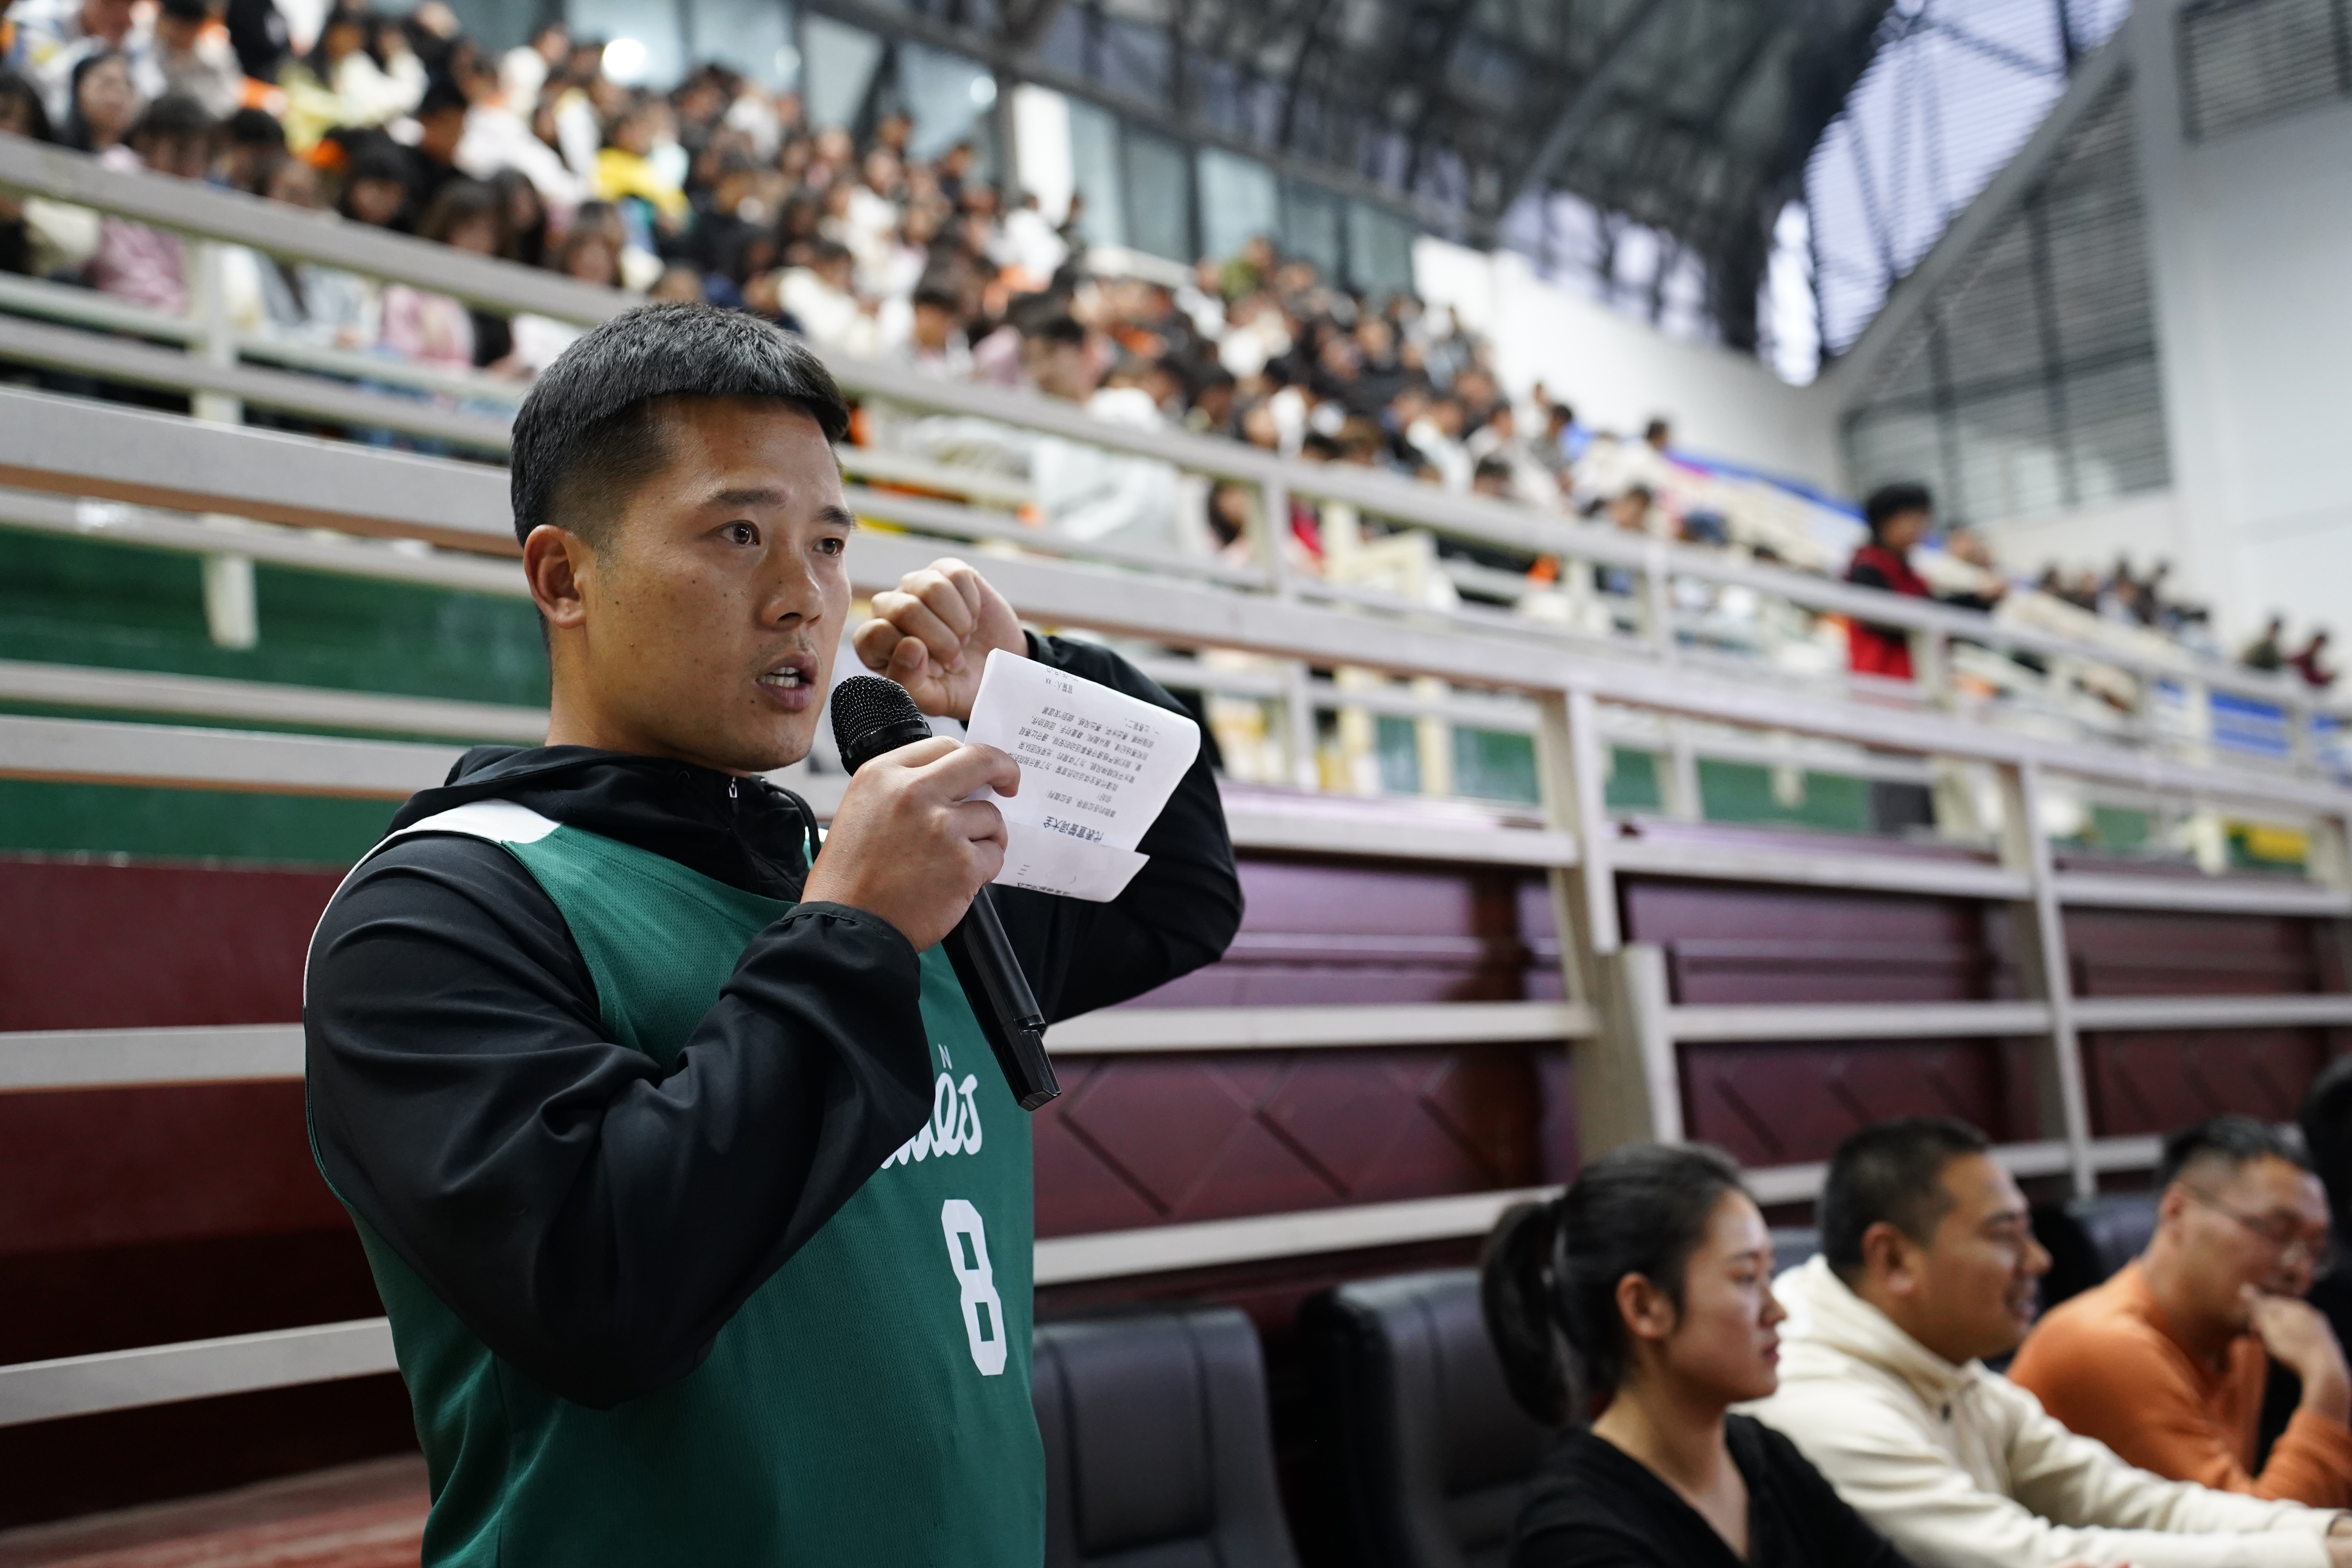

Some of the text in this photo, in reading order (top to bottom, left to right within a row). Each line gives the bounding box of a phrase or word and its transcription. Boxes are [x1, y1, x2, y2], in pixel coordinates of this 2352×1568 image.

[1043, 816, 1104, 842] 代表宣誓词大全
[941, 1199, 1007, 1376] 8
